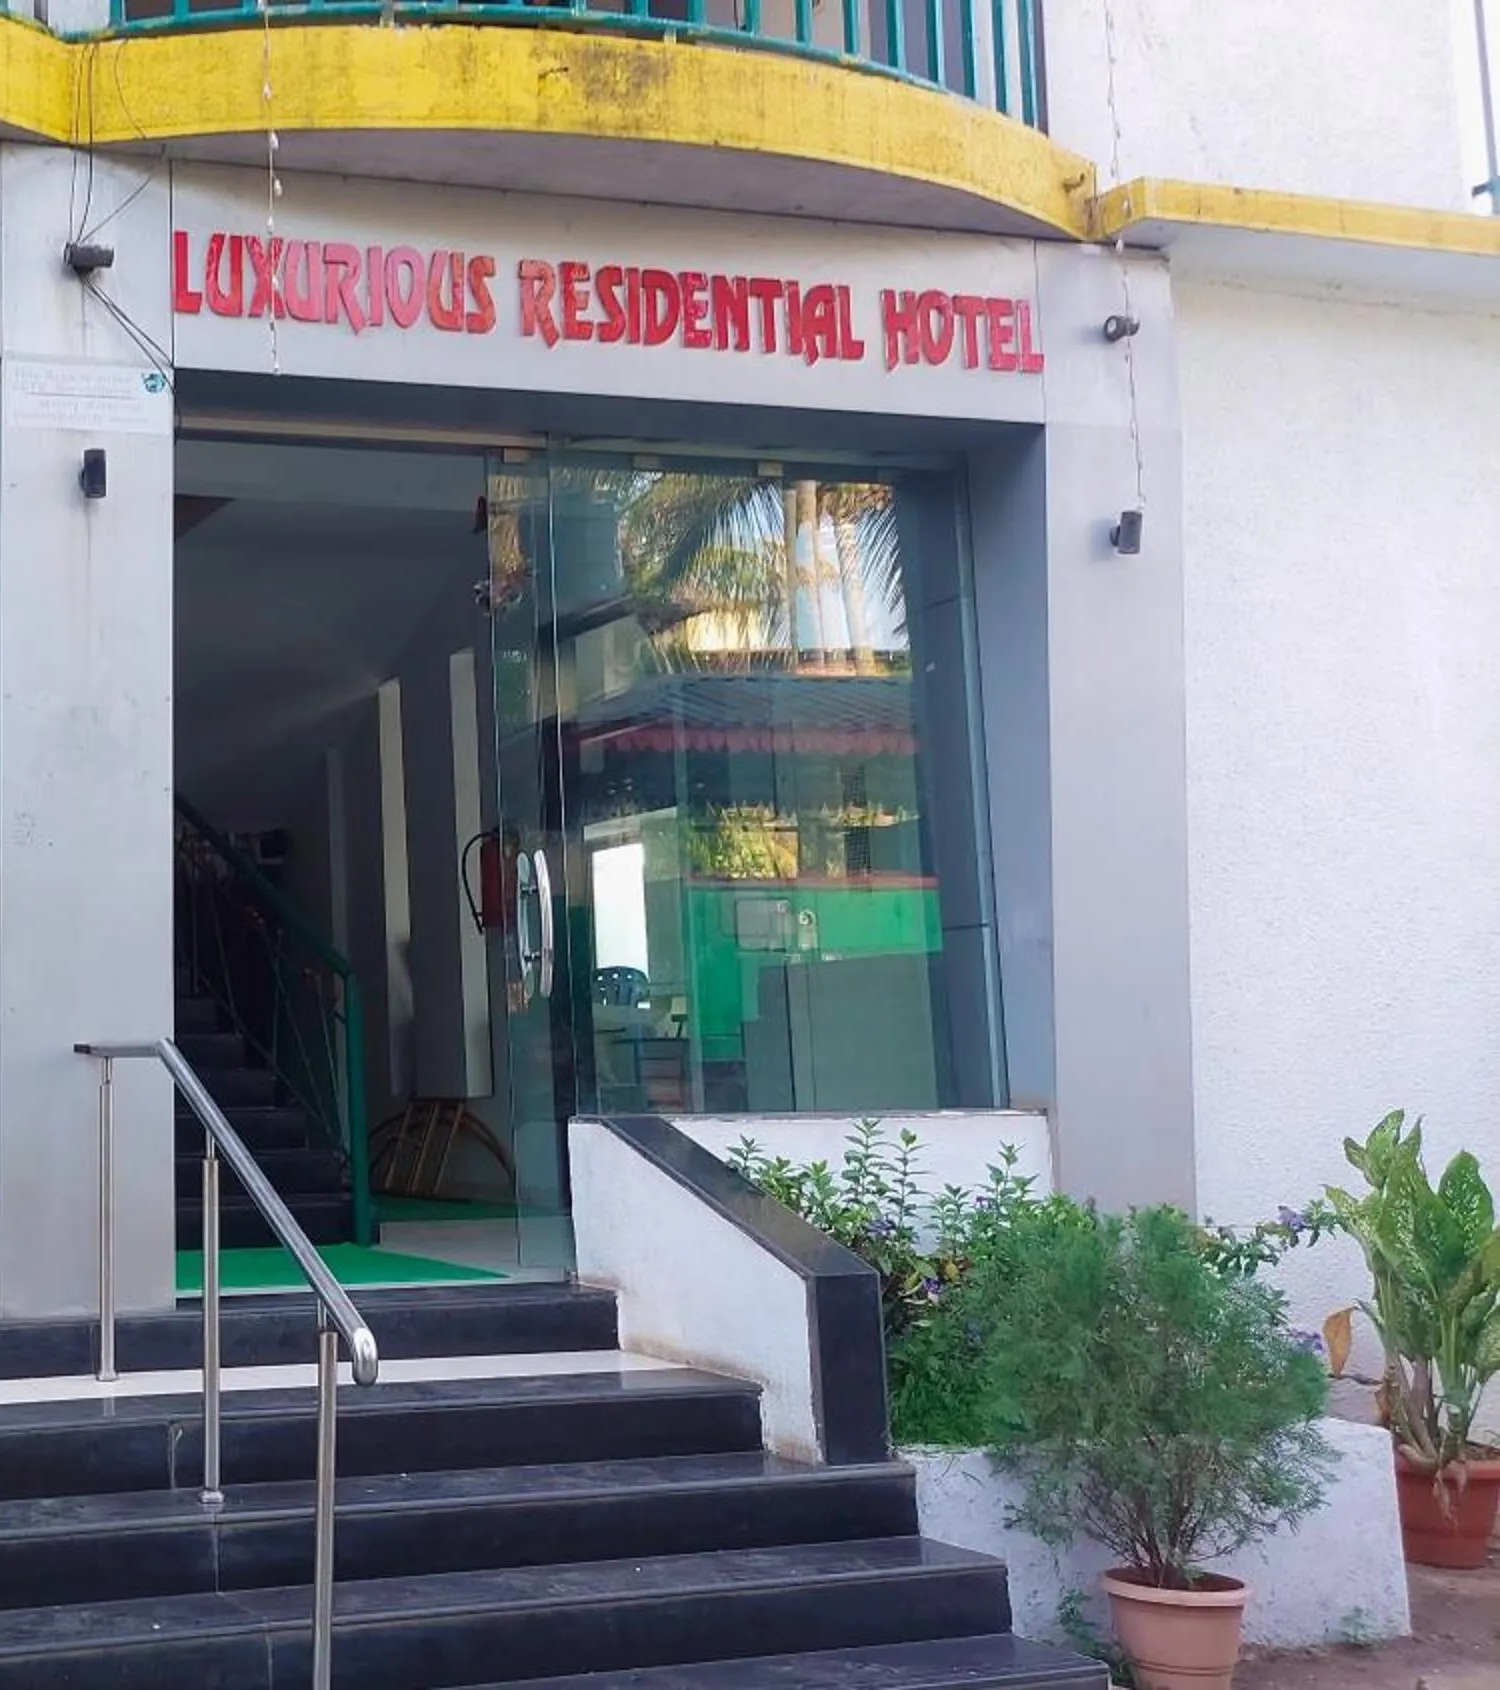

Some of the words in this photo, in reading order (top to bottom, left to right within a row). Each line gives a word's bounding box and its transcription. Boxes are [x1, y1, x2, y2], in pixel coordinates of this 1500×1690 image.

[174, 231, 497, 335] LUXURIOUS
[518, 259, 865, 366] RESIDENTIAL
[880, 289, 1045, 372] HOTEL
